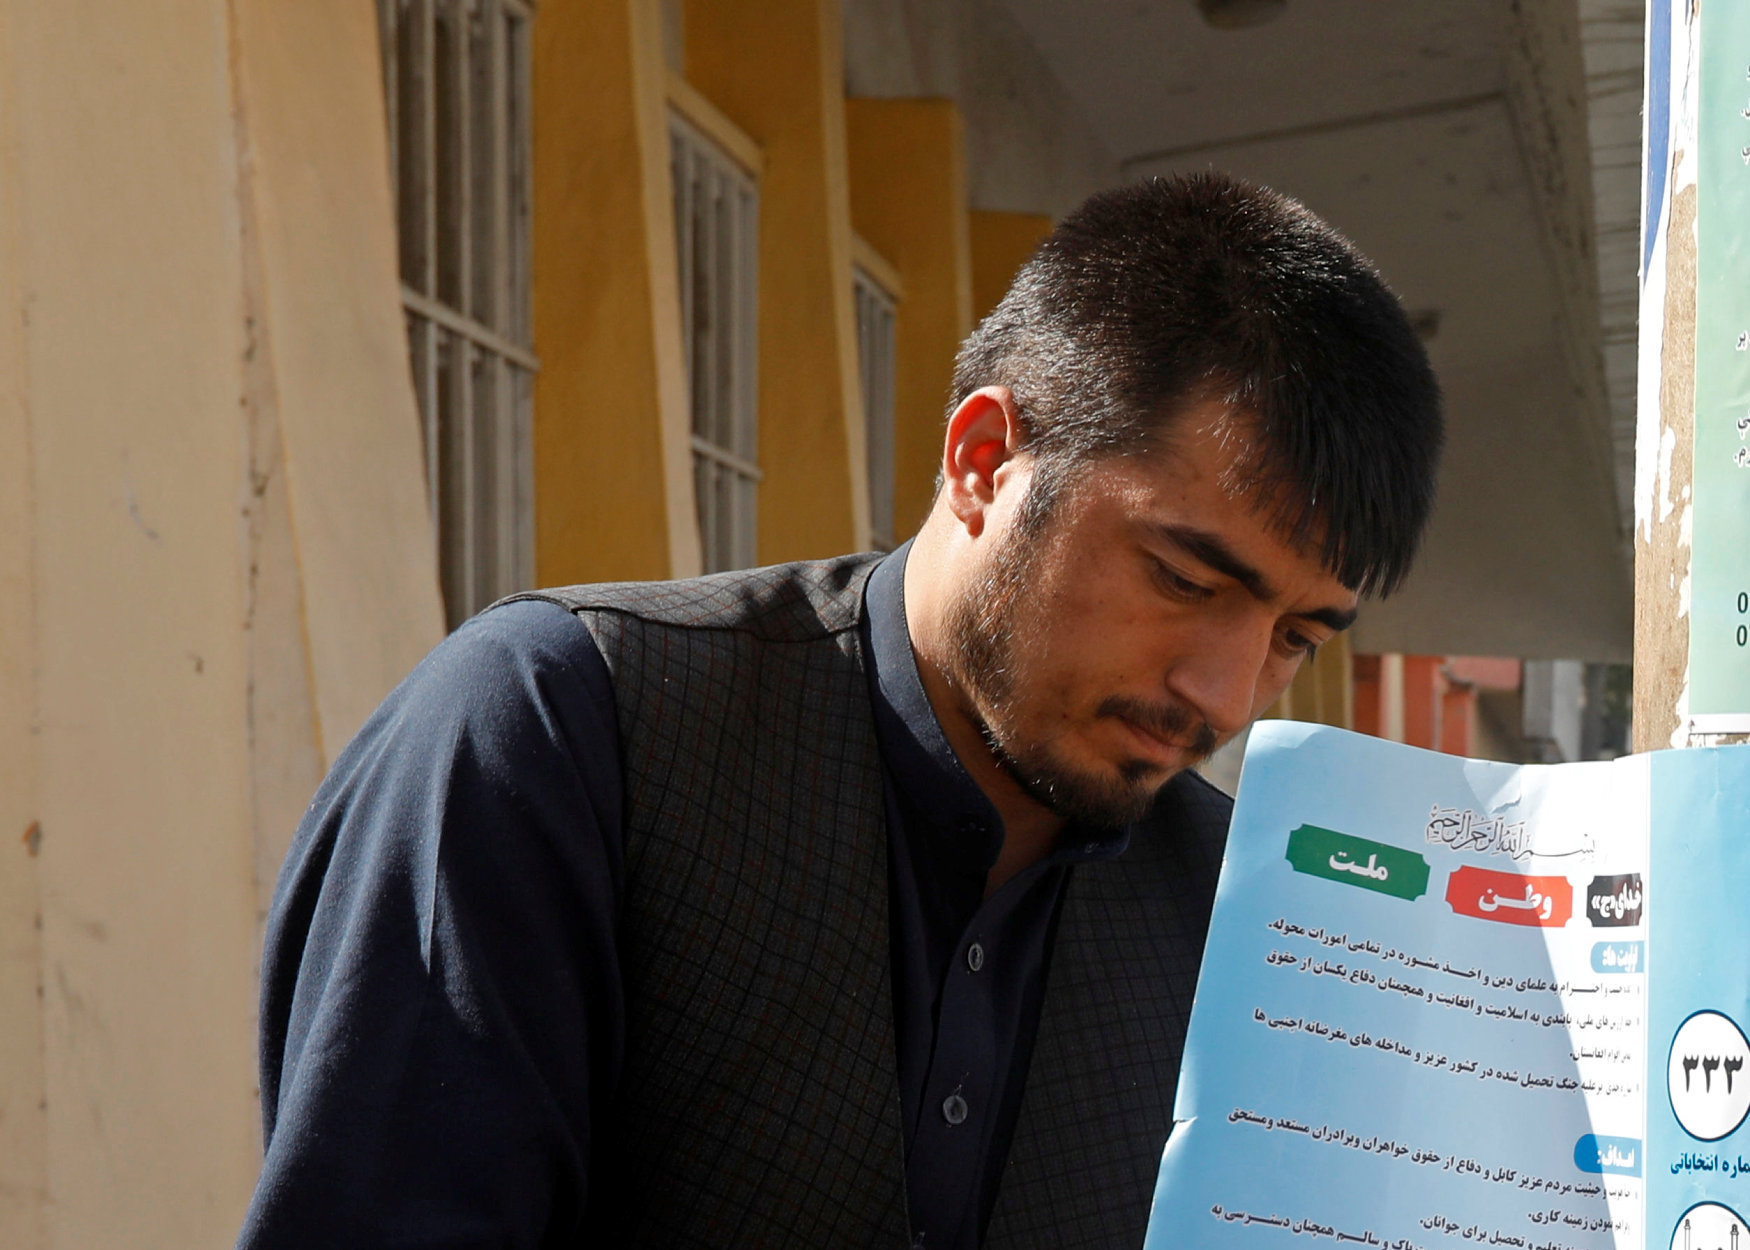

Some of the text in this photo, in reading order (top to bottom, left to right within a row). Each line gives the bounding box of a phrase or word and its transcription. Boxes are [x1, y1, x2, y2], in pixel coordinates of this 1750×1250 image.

[1329, 851, 1388, 881] ملت
[1478, 884, 1552, 920] وطن
[1682, 1054, 1744, 1095] ۳۳۳
